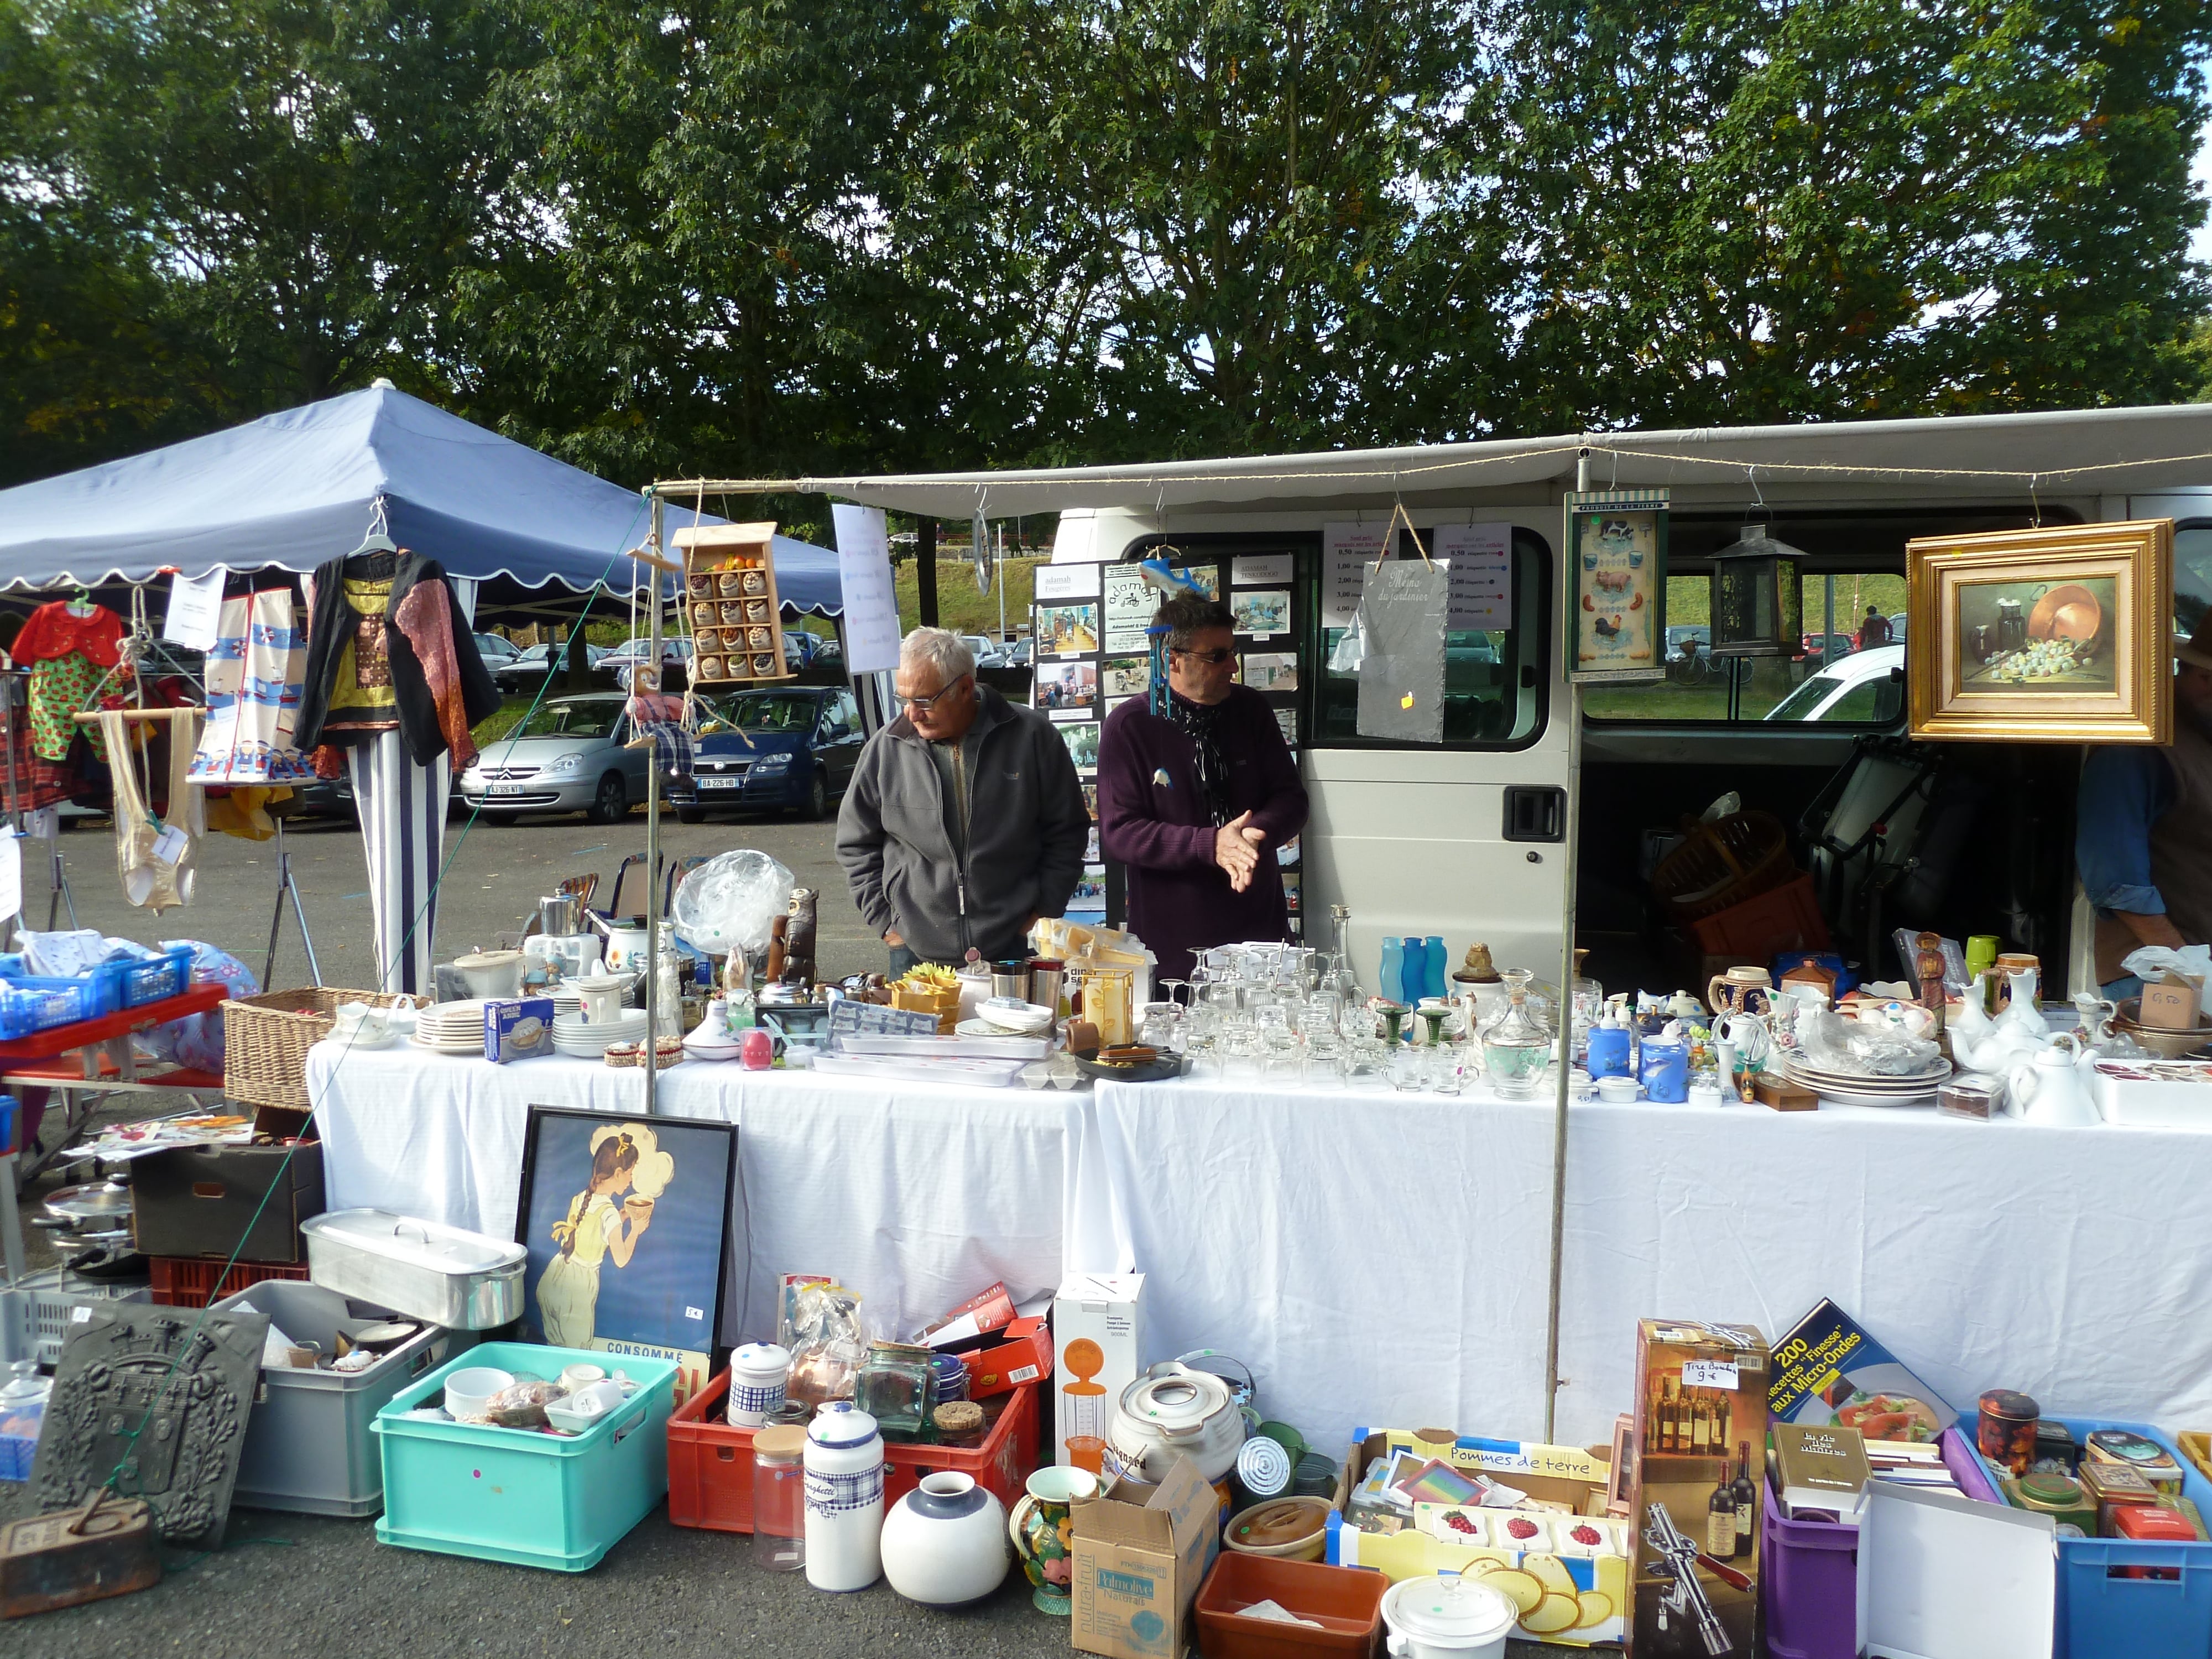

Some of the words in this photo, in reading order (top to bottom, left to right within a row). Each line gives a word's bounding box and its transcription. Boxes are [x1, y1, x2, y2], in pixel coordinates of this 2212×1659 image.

[1045, 575, 1071, 584] adamah
[1387, 588, 1429, 609] jardinier
[607, 1342, 684, 1364] CONSOMMÉ
[1774, 1337, 1808, 1369] 200
[1771, 1390, 1797, 1413] aux
[1790, 1332, 1861, 1394] Micro-Ondes
[1811, 1439, 1832, 1448] des
[1451, 1447, 1512, 1465] Pommes
[1517, 1455, 1540, 1469] de
[1545, 1458, 1590, 1474] terre
[1097, 1569, 1152, 1596] Palmolive
[1104, 1589, 1146, 1606] Naturals
